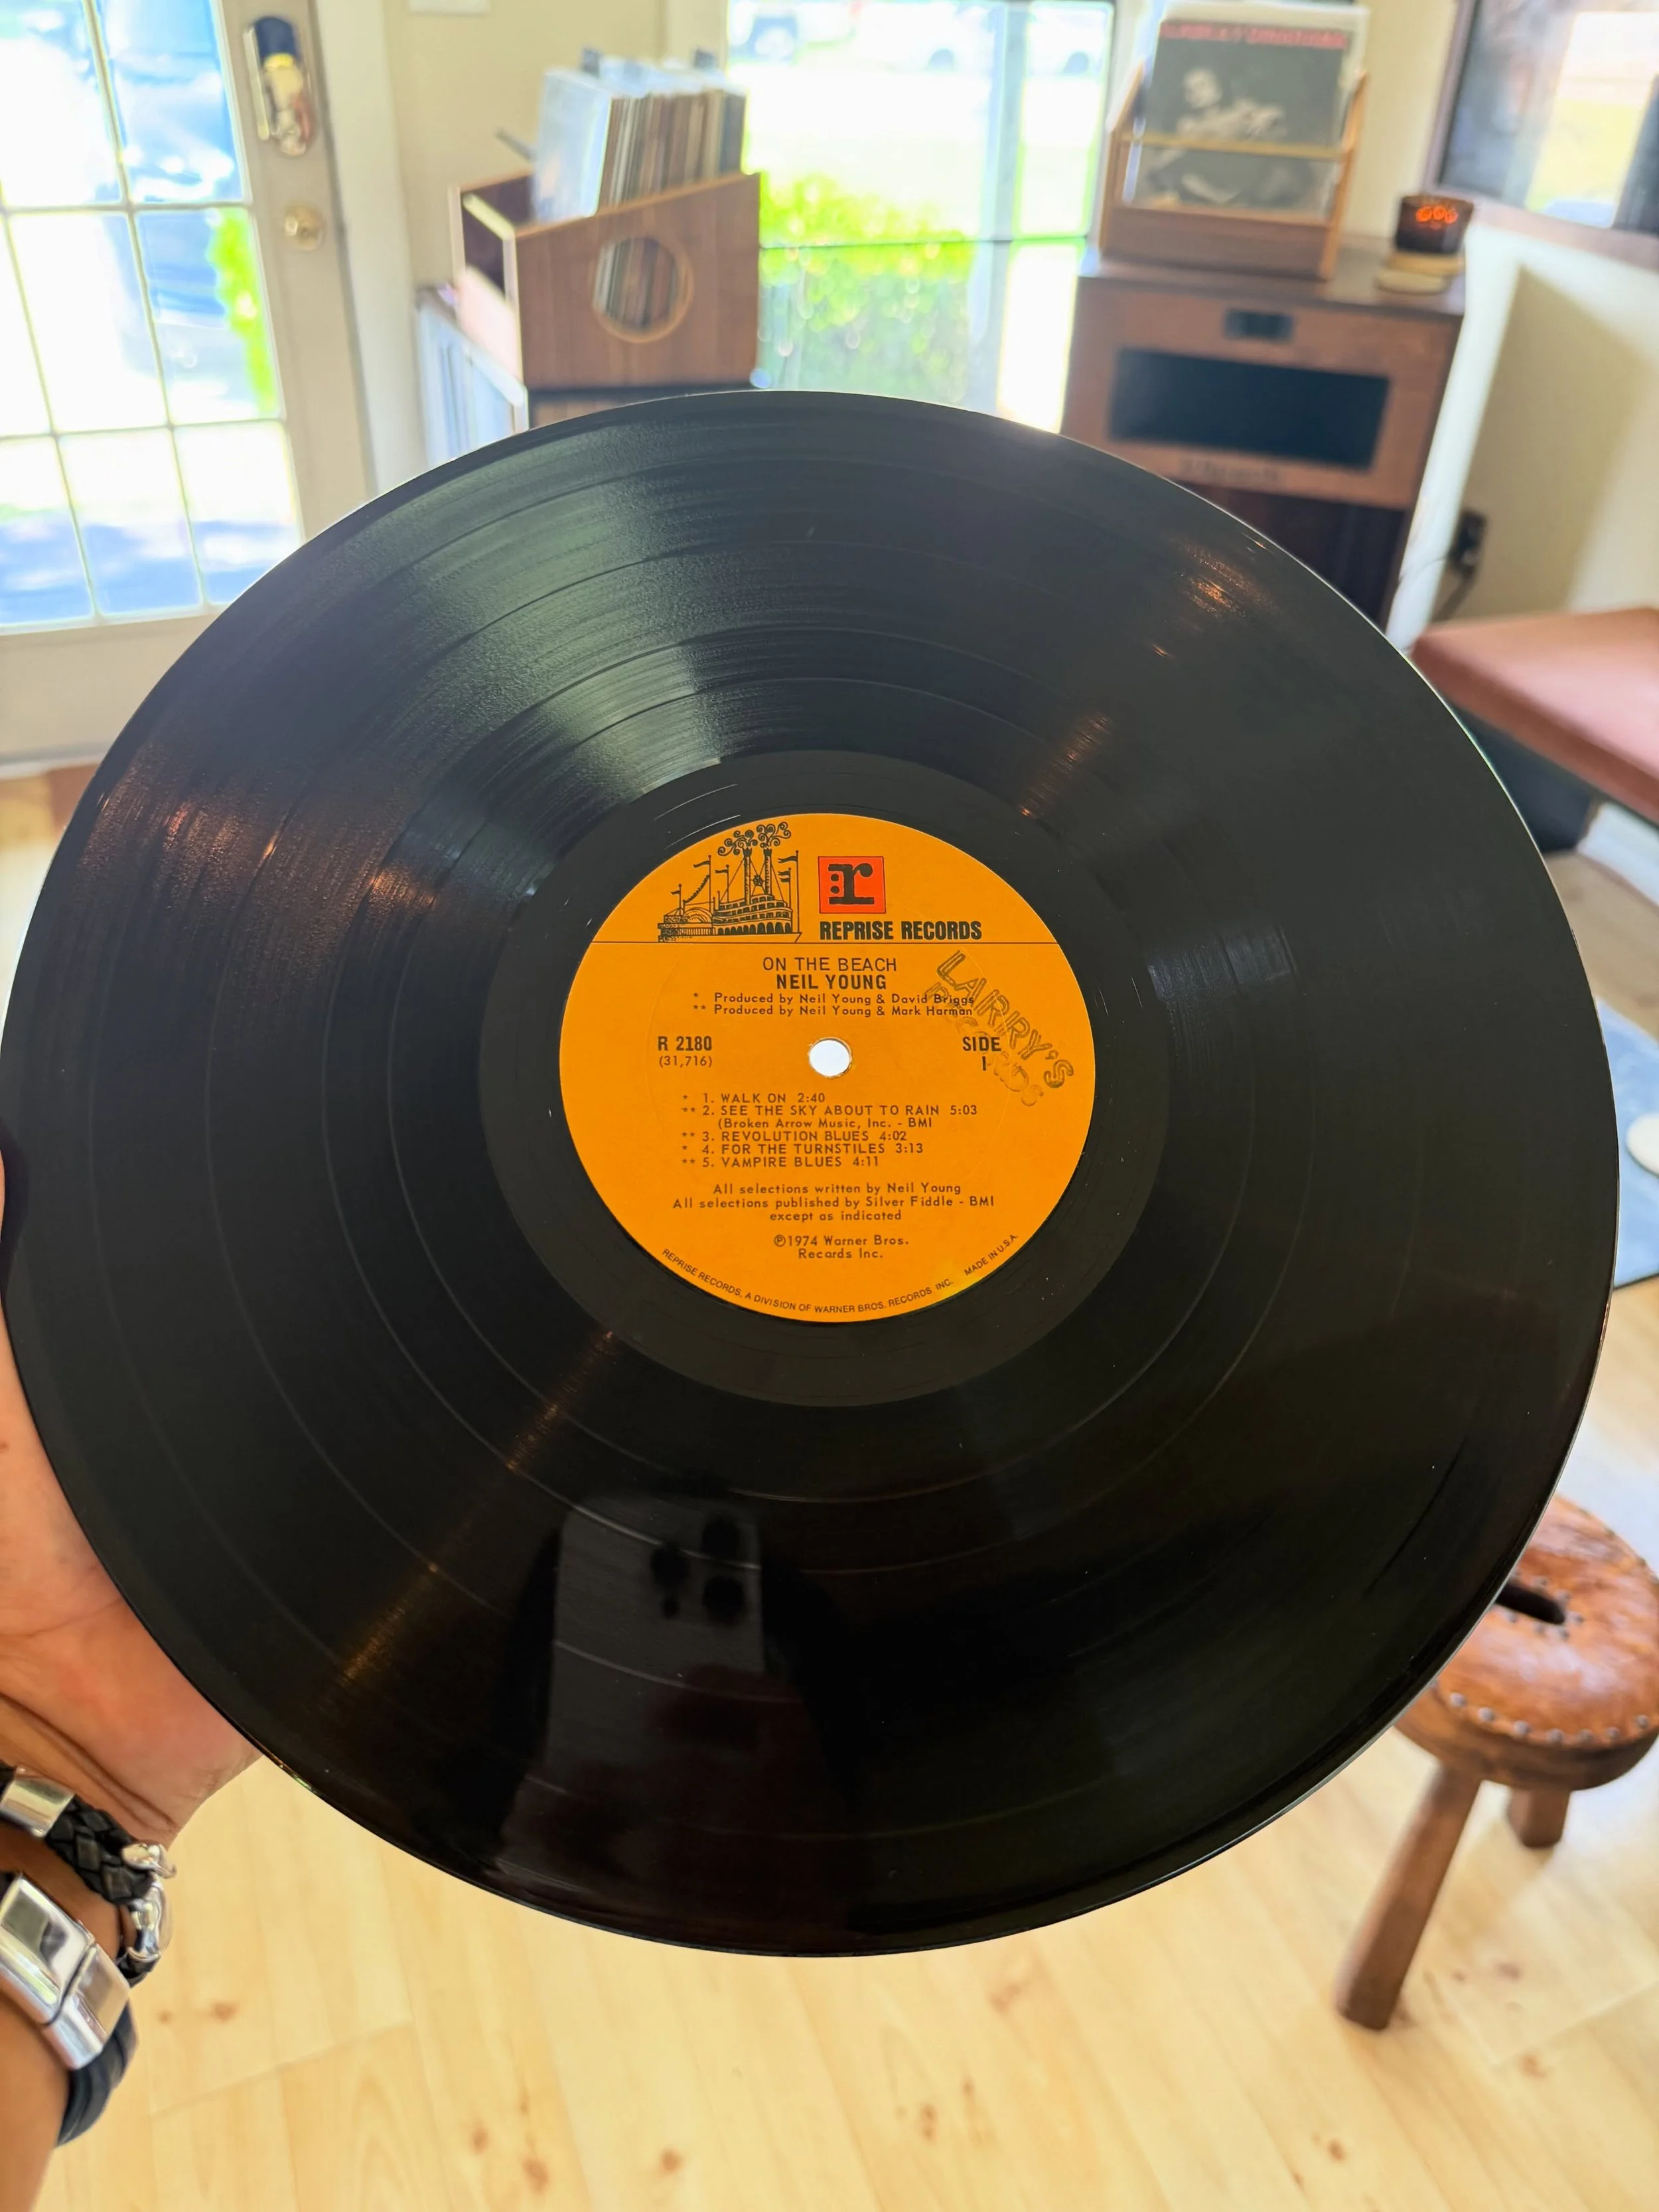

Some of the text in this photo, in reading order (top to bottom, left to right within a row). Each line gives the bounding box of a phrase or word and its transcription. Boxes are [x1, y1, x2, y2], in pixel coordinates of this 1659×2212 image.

[820, 921, 981, 940] REPRISE RECORDS
[763, 957, 896, 971] ON THE BEACH
[777, 974, 886, 990] NEIL YOUNG
[715, 993, 974, 1005] Produced by Neil Young & David Briggs
[715, 1004, 972, 1017] Produced by Neil Young & Mark Harman
[658, 1036, 711, 1051] R 2180
[963, 1037, 1001, 1051] SIDE
[660, 1056, 712, 1067] (31,716)
[704, 1093, 825, 1102] 1. WALK ON 2:40
[703, 1105, 977, 1116] 2. SEE THE SKY ABOUT TO RAIN 5:03
[719, 1118, 768, 1130] (Broken
[776, 1119, 812, 1128] Arrow
[819, 1119, 860, 1129] Music,
[868, 1118, 891, 1128] Inc.
[908, 1118, 931, 1127] BMI
[703, 1131, 906, 1142] 3. REVOLUTION BLUES 4:02
[703, 1143, 922, 1154] 4. FOR THE TURNSTILES 3:13
[703, 1156, 877, 1167] 5. VAMPIRE BLUES 4:11
[714, 1182, 960, 1195] All selections written by Neil Young
[674, 1197, 692, 1208] All
[700, 1197, 768, 1208] selections
[776, 1197, 839, 1209] published
[845, 1197, 859, 1209] by
[866, 1197, 904, 1207] Silver
[911, 1196, 952, 1206] Fiddle
[970, 1196, 993, 1206] BMI
[770, 1213, 813, 1222] except
[841, 1210, 901, 1220] indicated
[824, 1236, 867, 1245] Warner
[875, 1234, 908, 1245] Bros.
[799, 1248, 883, 1258] Records Inc.
[964, 1233, 1019, 1276] MADE IN U.S.A.
[662, 1249, 698, 1276] REPRISE
[754, 1294, 796, 1310] DIVISION
[857, 1302, 887, 1312] BROS.
[888, 1288, 932, 1307] RECORDS
